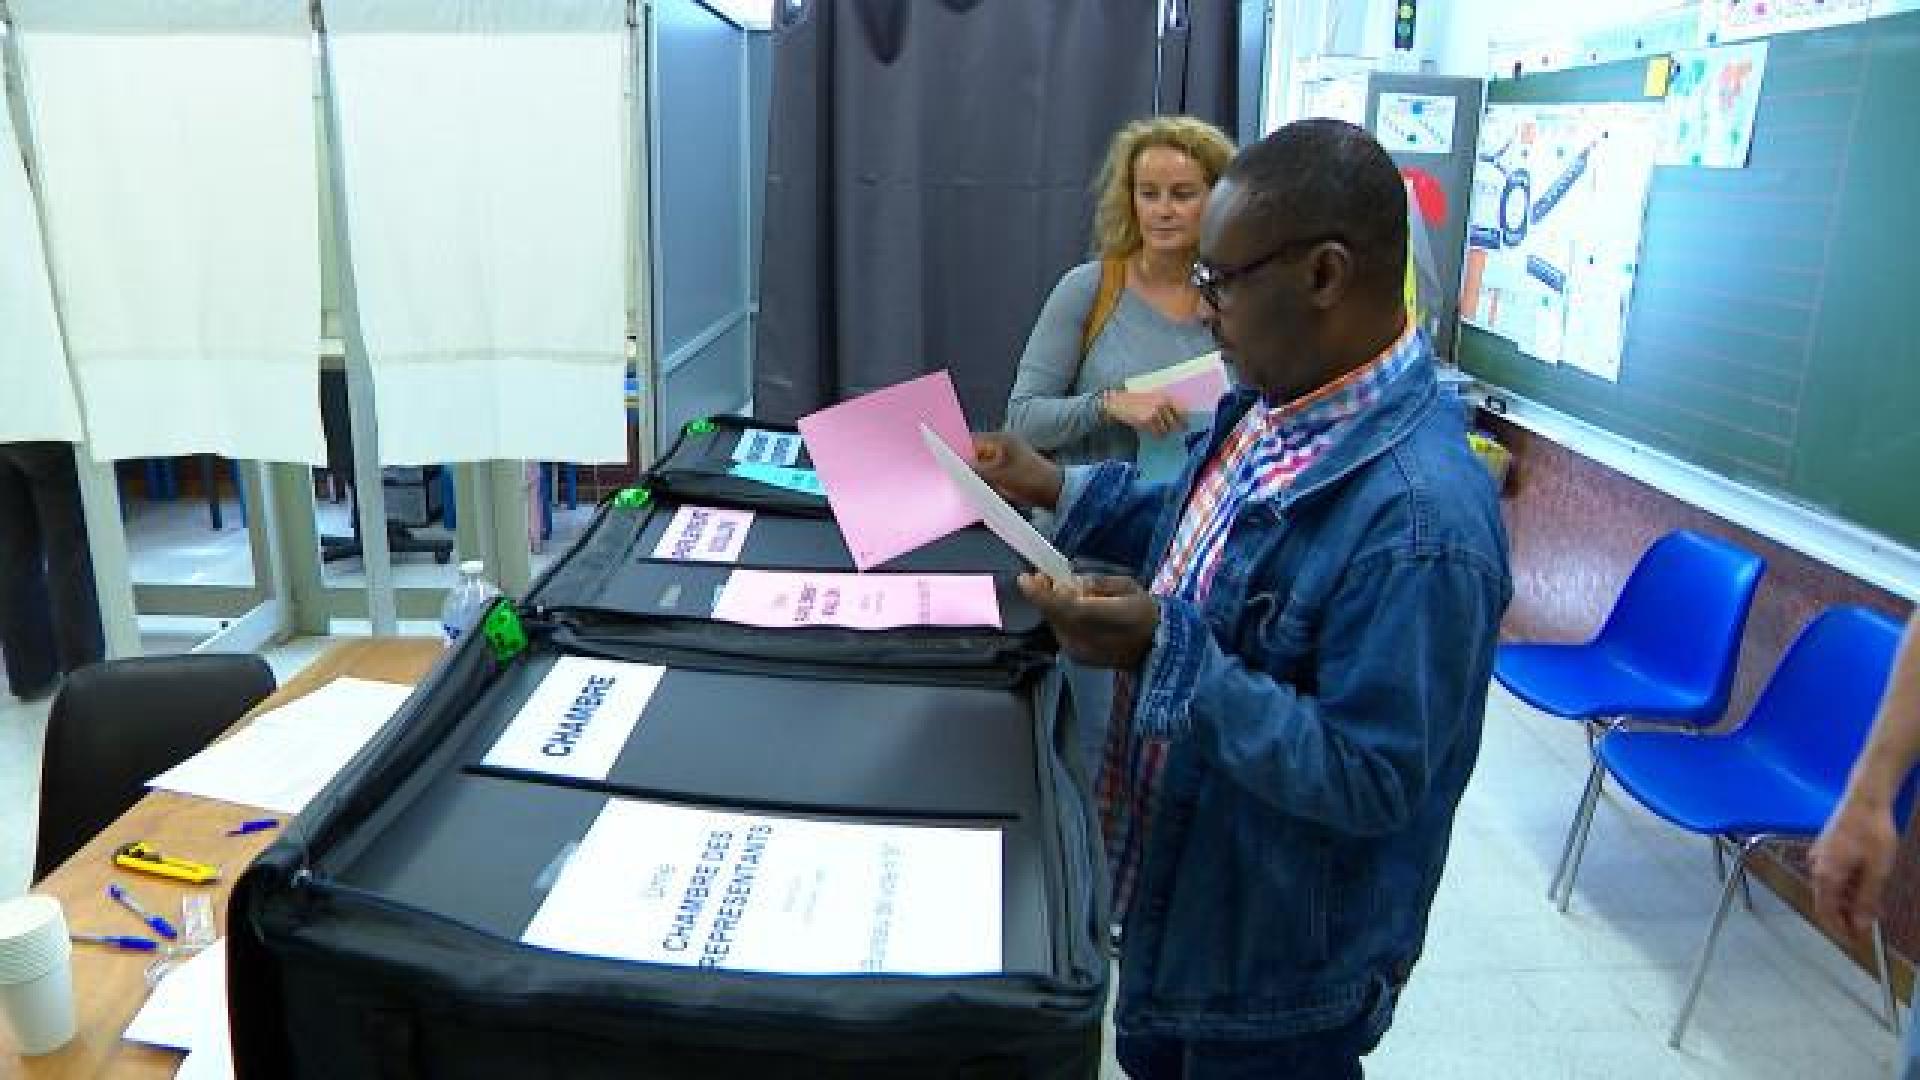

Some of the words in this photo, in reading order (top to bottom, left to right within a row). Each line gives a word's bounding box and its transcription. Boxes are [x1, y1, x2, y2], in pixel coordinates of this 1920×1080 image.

[541, 673, 616, 757] CHAMBRE
[662, 863, 720, 951] CHAMBRE
[701, 830, 733, 862] DES
[699, 824, 775, 970] REPRESENTANTS
